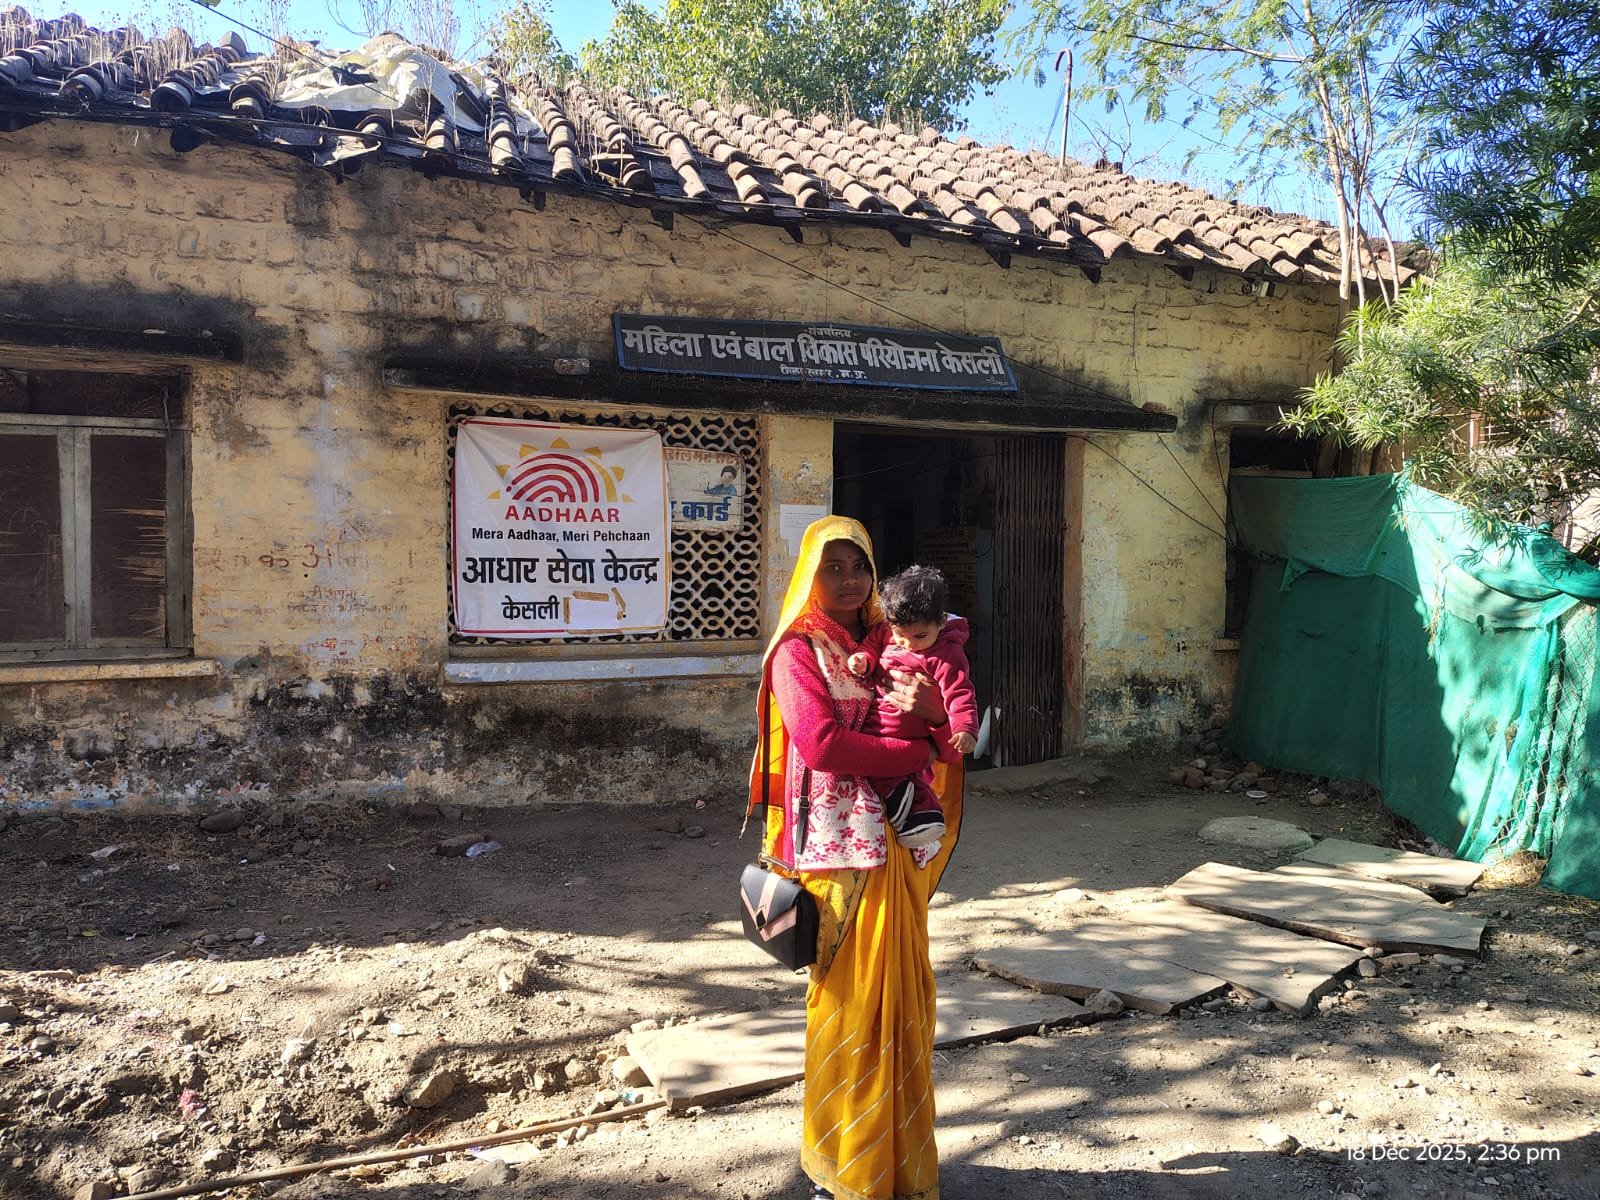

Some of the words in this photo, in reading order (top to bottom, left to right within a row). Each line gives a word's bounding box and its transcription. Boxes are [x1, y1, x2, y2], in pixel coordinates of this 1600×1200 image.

[621, 325, 704, 358] महिला
[707, 331, 742, 360] एवं
[744, 336, 795, 363] बाल
[797, 333, 859, 366] विकास
[858, 337, 941, 373] परियोजना
[935, 341, 1006, 375] केसली
[505, 505, 621, 523] AADHAAR
[681, 496, 732, 522] कार्ड
[472, 528, 504, 540] Mera
[507, 529, 559, 543] Aadhaar,
[562, 530, 590, 542] Meri
[593, 530, 650, 542] Pehchaan
[462, 557, 539, 584] आधार
[547, 548, 595, 584] सेवा
[601, 548, 660, 584] केन्द्र
[501, 595, 560, 620] केसली
